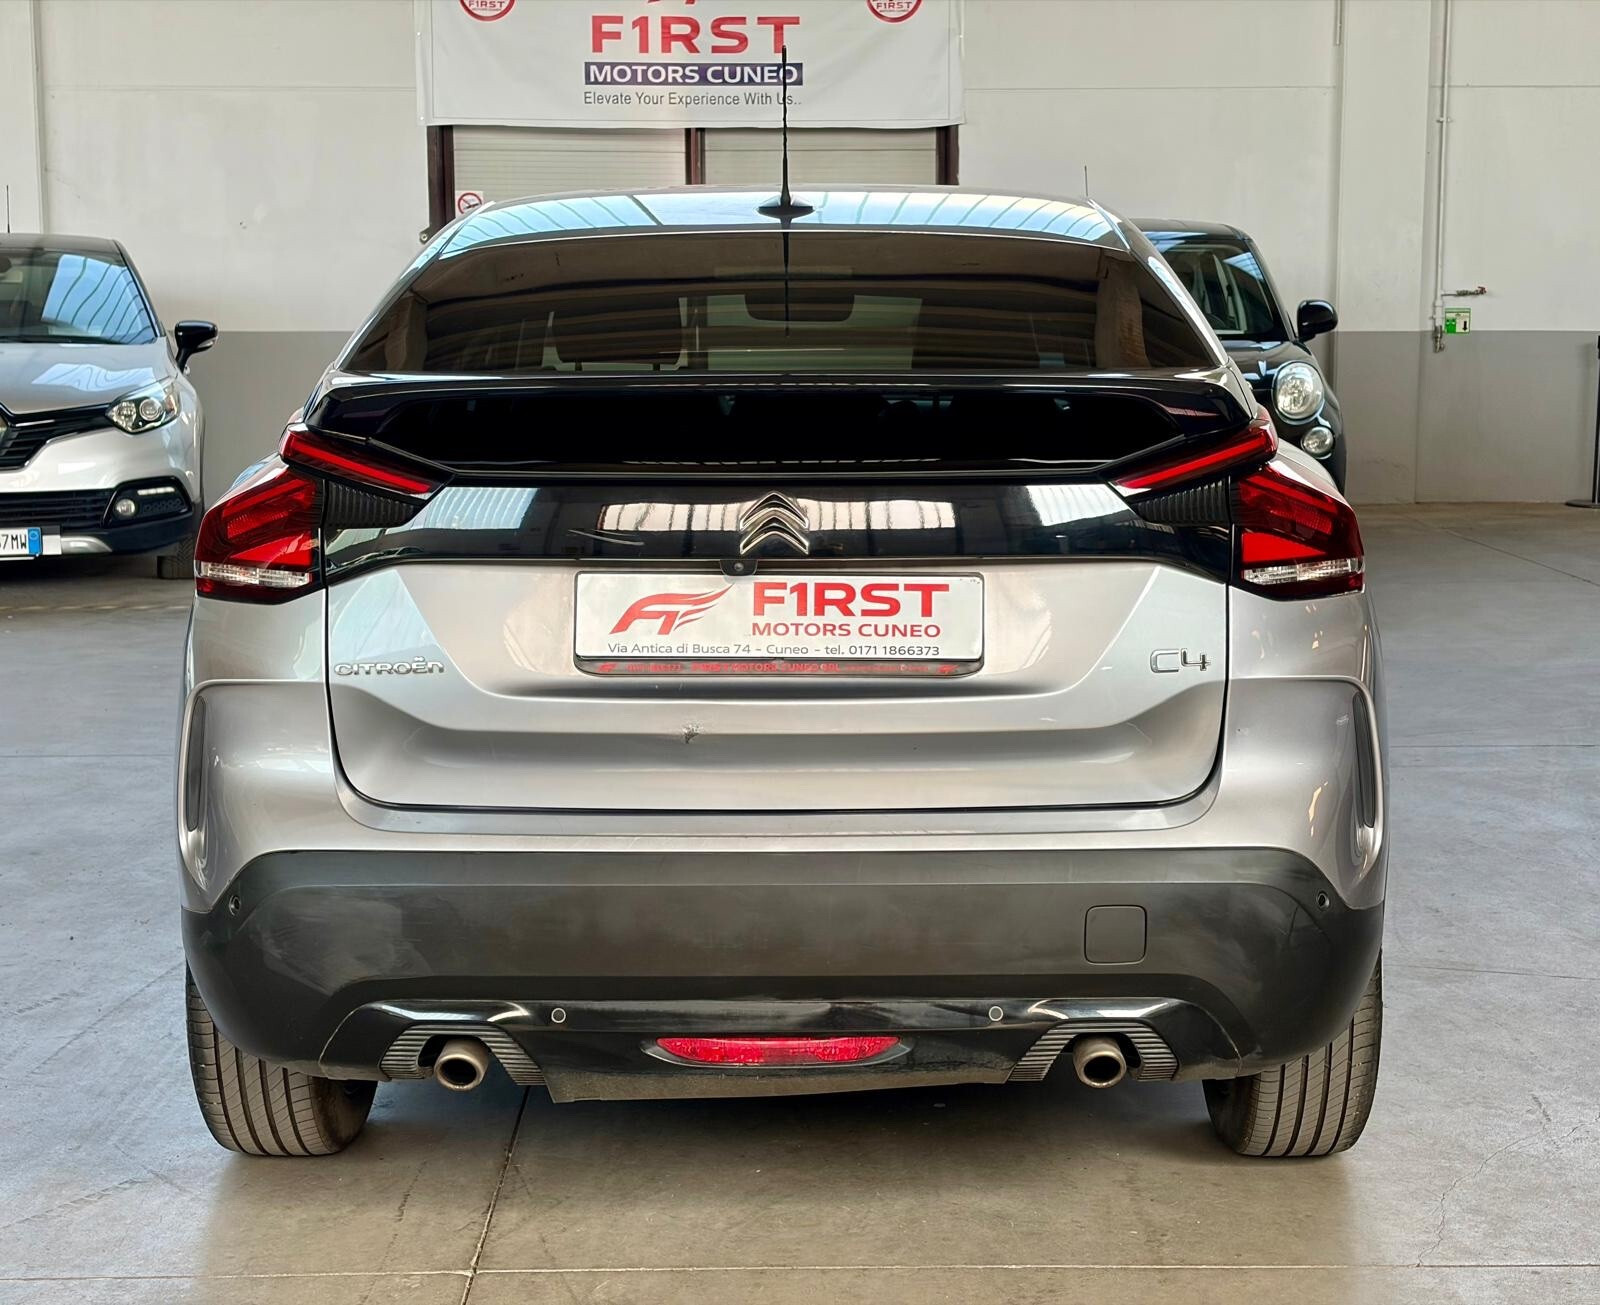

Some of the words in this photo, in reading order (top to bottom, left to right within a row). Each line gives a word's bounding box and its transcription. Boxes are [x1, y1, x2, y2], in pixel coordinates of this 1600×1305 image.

[591, 15, 800, 54] F1RST
[589, 65, 700, 83] MOTORS
[706, 65, 798, 83] CUNEO
[584, 92, 632, 105] Elevate
[635, 92, 664, 105] Your
[668, 92, 740, 108] Experience
[743, 92, 773, 105] With
[0, 534, 27, 549] 7MW
[753, 582, 949, 618] F1RST
[752, 622, 851, 637] MOTORS
[858, 623, 941, 638] CUNEO
[608, 643, 628, 654] Via
[631, 643, 673, 654] Antica
[677, 643, 688, 654] di
[692, 644, 730, 654] Busca
[734, 644, 750, 654] 74
[766, 645, 808, 655] Cuneo
[825, 645, 845, 655] tel.
[848, 646, 877, 656] 0171
[883, 646, 940, 656] 1866373
[1150, 648, 1211, 673] C4
